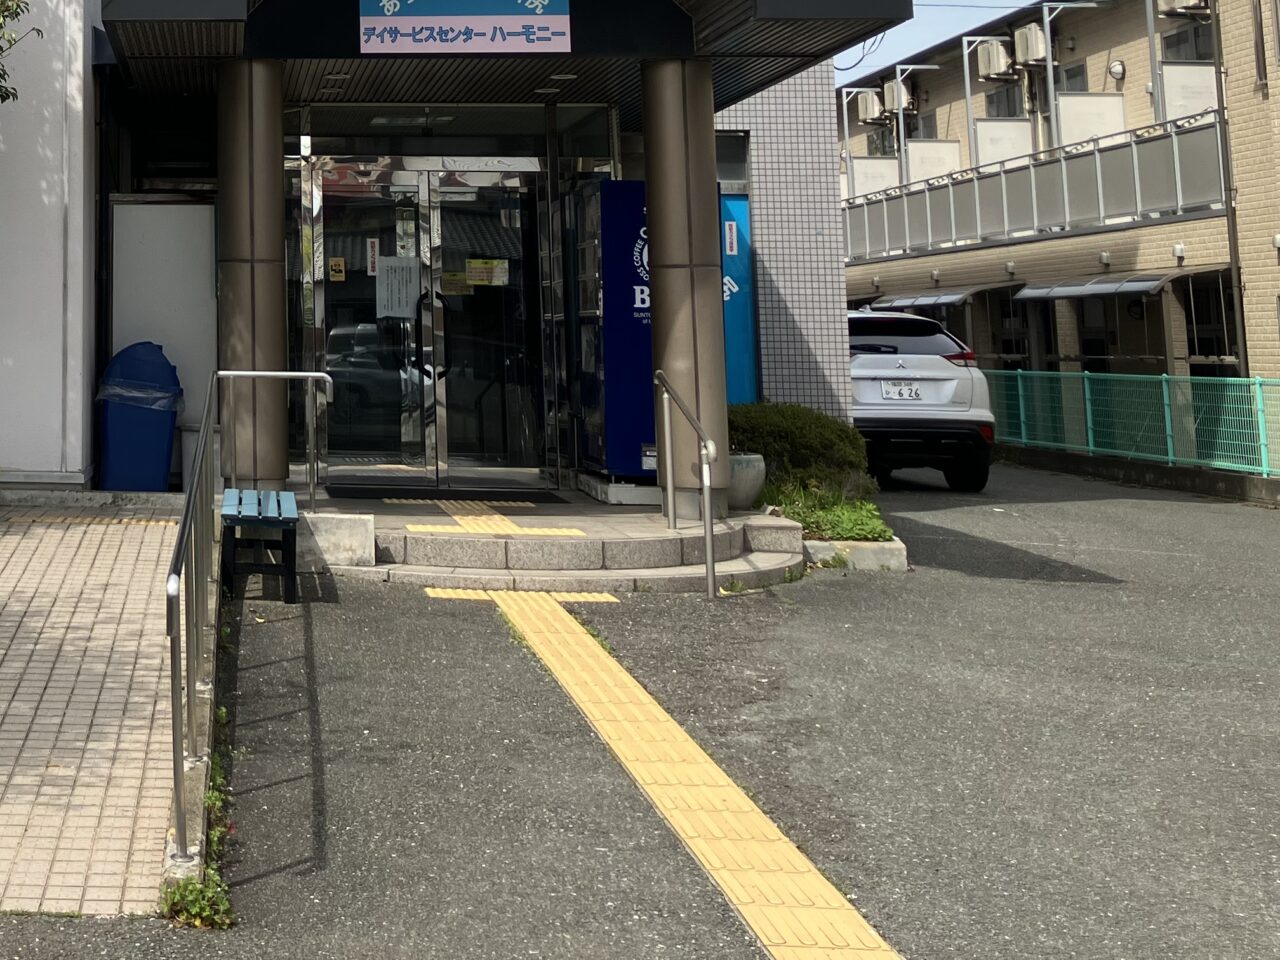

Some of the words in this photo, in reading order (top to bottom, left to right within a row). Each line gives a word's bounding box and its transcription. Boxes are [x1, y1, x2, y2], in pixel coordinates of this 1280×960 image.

[362, 26, 486, 44] デイサービスセンター
[490, 24, 566, 44] ハーモニー
